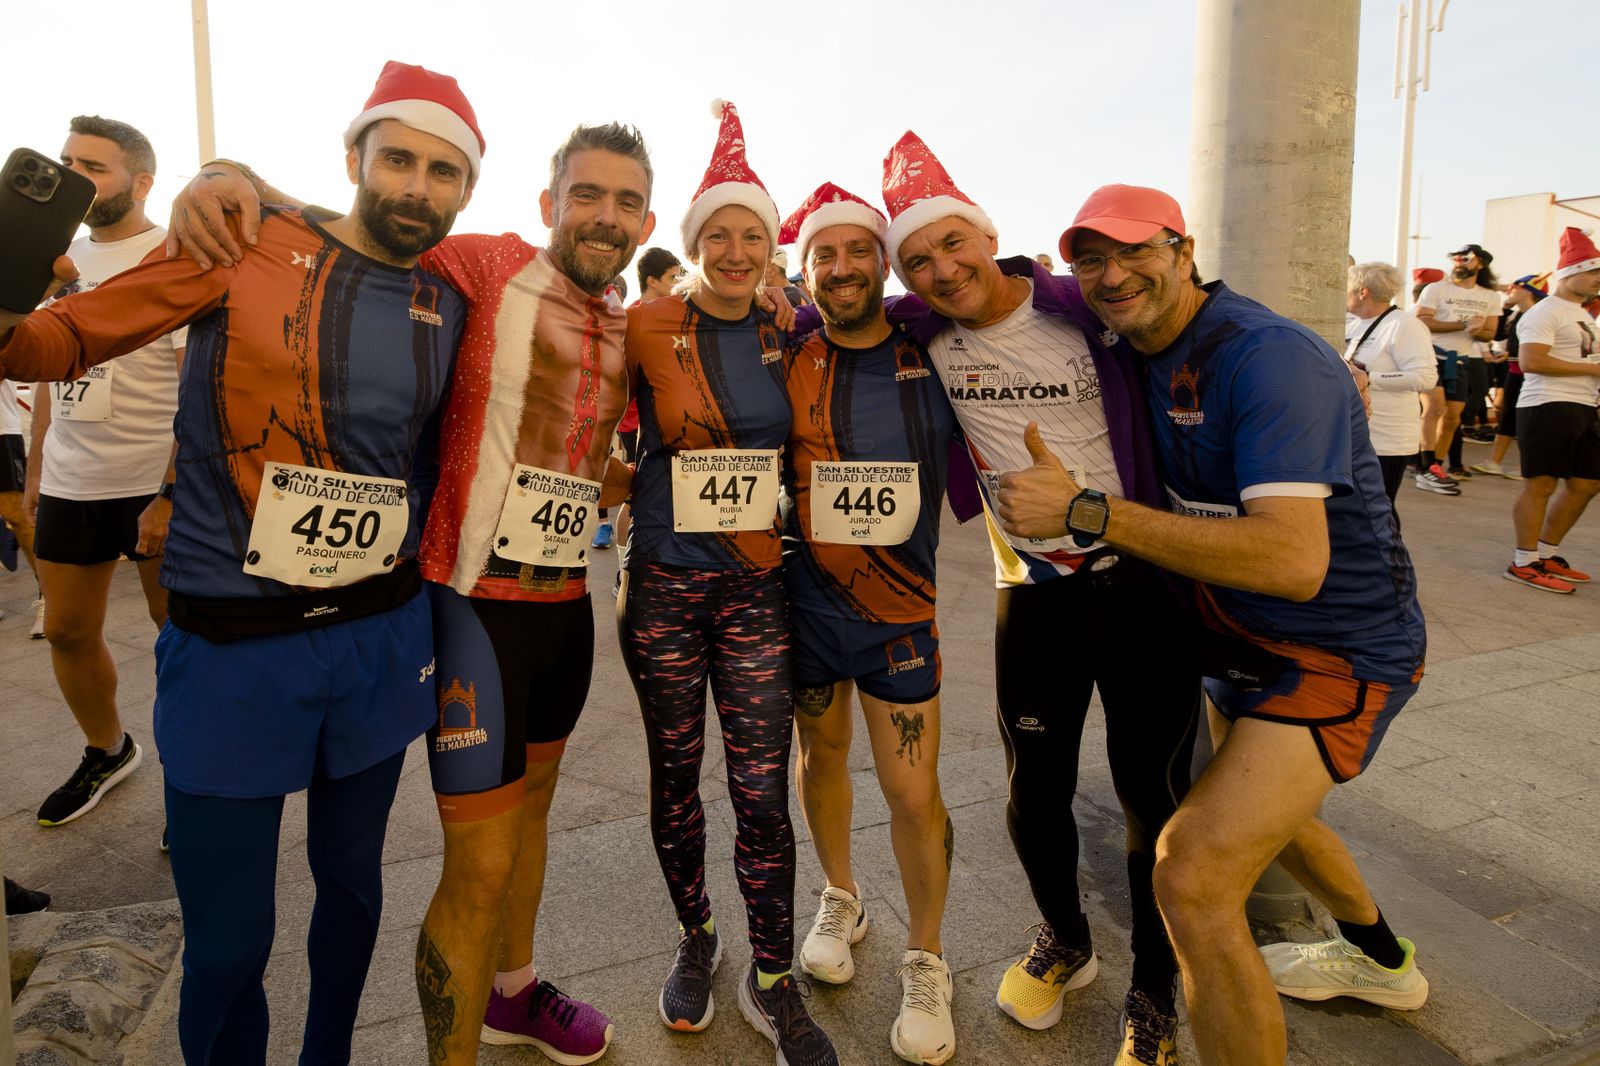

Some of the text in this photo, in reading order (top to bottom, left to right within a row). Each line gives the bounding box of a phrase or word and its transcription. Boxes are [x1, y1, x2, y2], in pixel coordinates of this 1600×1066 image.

[965, 362, 999, 371] EDICIÓN
[55, 381, 91, 402] 127
[949, 382, 1070, 400] MARATÓN
[680, 455, 771, 463] SAN SILVESTRE
[681, 463, 726, 472] CIUDAD
[728, 463, 741, 471] DE
[818, 465, 911, 474] SAN SILVESTRE
[279, 468, 401, 494] SAN SILVESTRE
[523, 470, 551, 483] SAN
[818, 473, 858, 483] CIUDAD
[862, 474, 876, 483] DE
[350, 491, 366, 503] DE
[567, 489, 580, 500] DE
[699, 476, 758, 505] 447
[833, 486, 896, 516] 446
[531, 499, 588, 537] 468
[848, 517, 881, 525] JURADO
[291, 504, 381, 549] 450
[543, 534, 570, 544] SATANIX
[296, 546, 366, 559] PASQUINERO
[436, 728, 487, 743] PUERTO REAL
